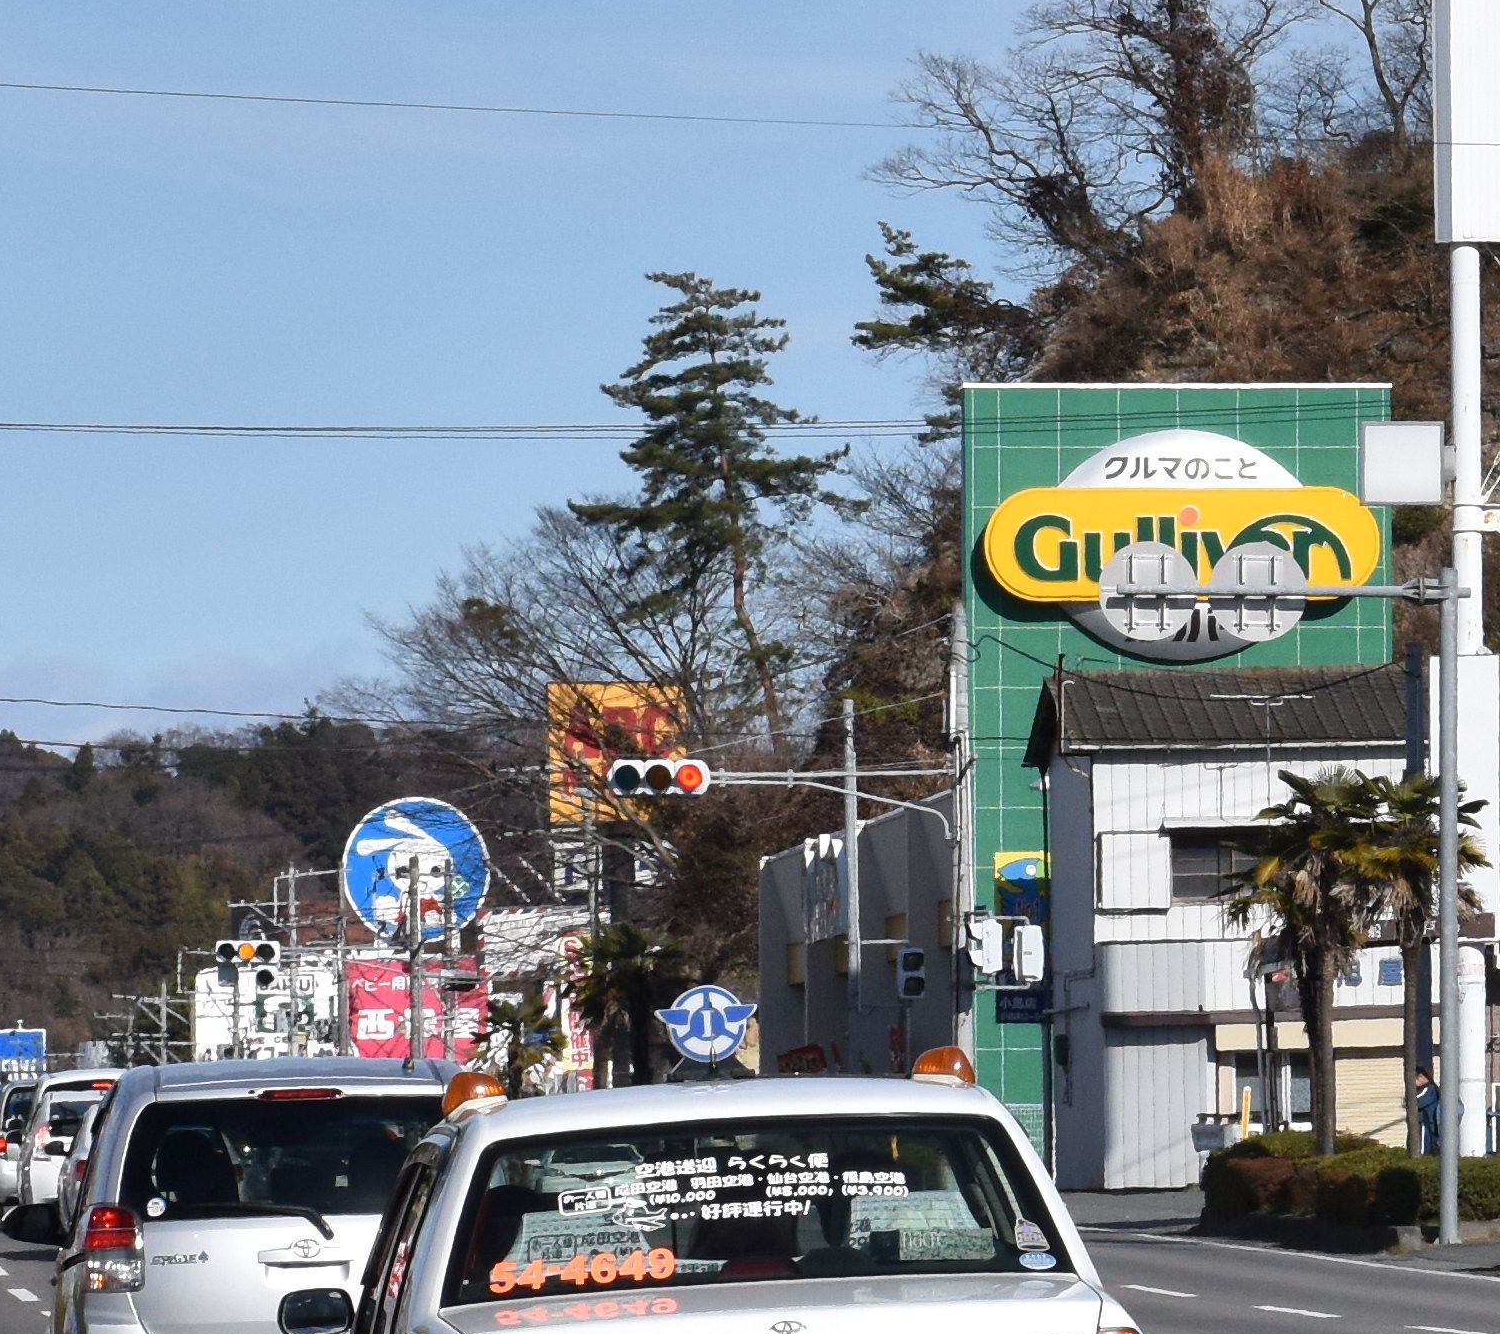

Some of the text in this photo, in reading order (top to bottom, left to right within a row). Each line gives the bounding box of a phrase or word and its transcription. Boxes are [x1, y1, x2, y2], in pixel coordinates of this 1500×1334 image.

[1105, 456, 1258, 481] クルマのこと
[635, 1152, 829, 1179] 空港送迎 らくらく便
[614, 1178, 678, 1197] 成田空港
[489, 1247, 677, 1294] 54-4649
